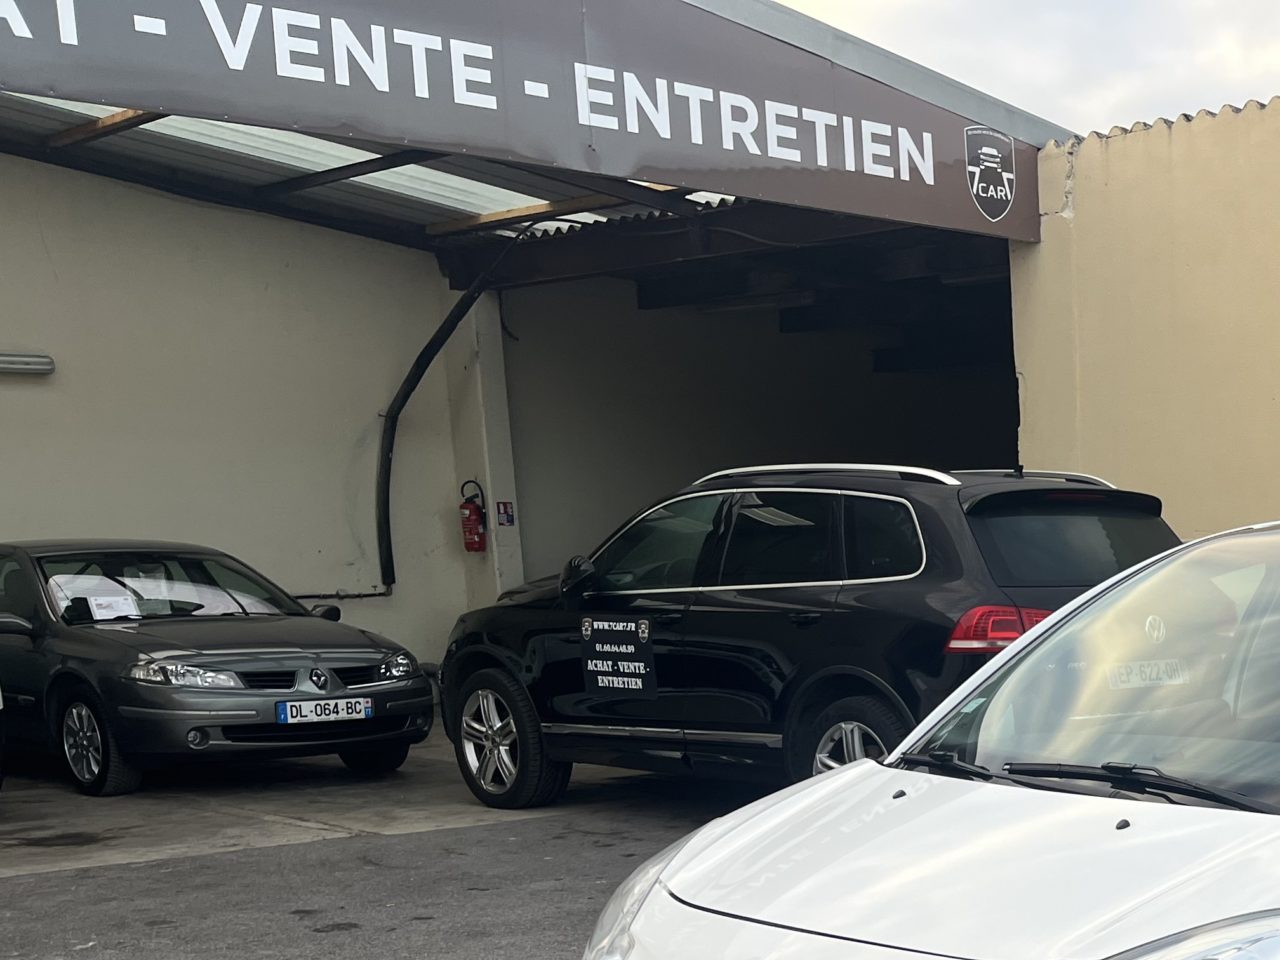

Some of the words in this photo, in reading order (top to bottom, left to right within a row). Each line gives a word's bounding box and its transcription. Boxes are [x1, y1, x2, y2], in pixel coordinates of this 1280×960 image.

[199, 0, 498, 110] VENTE
[574, 62, 935, 186] ENTRETIEN
[587, 660, 612, 671] ACHAT
[618, 662, 646, 673] VENTE
[597, 676, 643, 689] ENTRETIEN
[289, 701, 362, 719] DL-064-BC
